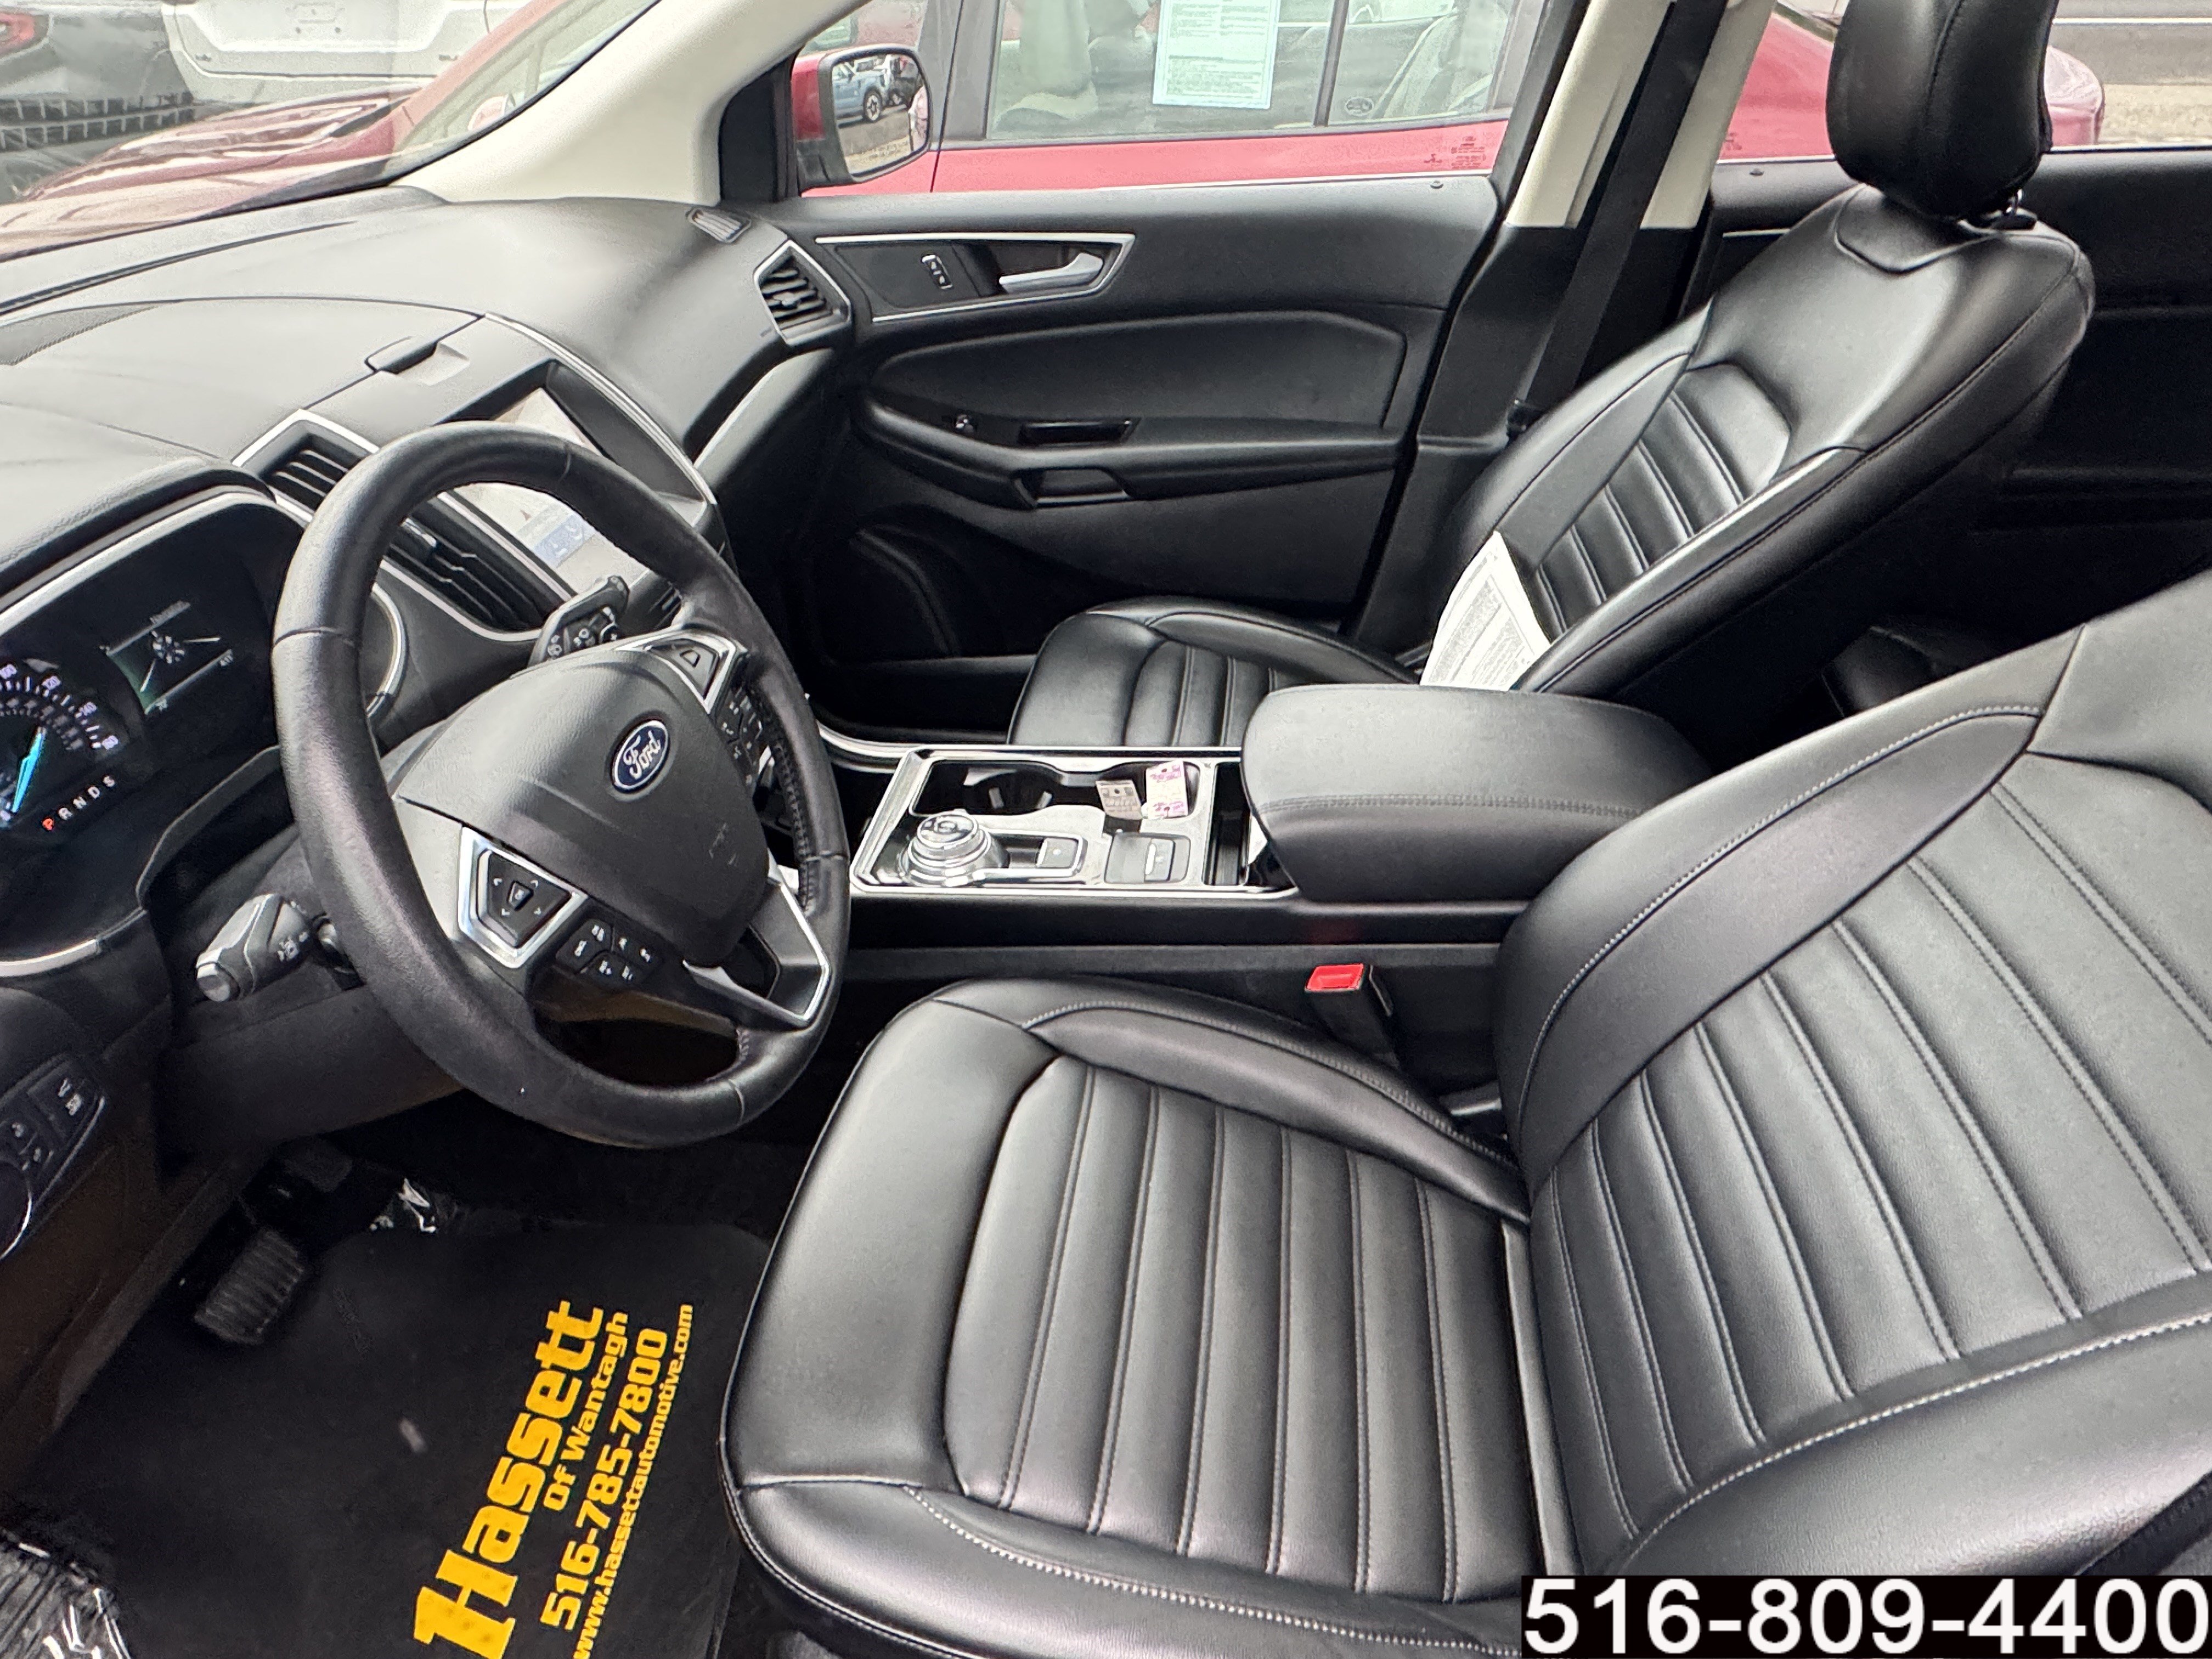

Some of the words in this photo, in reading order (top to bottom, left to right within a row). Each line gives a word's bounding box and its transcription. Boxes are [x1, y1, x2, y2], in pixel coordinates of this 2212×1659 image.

[42, 817, 55, 831] P
[58, 808, 73, 821] R
[73, 796, 87, 809] N
[88, 786, 101, 799] D
[103, 776, 115, 788] S
[623, 730, 662, 778] Ford
[561, 1312, 628, 1460] Wantagh
[540, 1328, 668, 1631] 516-785-7800
[573, 1305, 693, 1659] www.hassettautomotive.com
